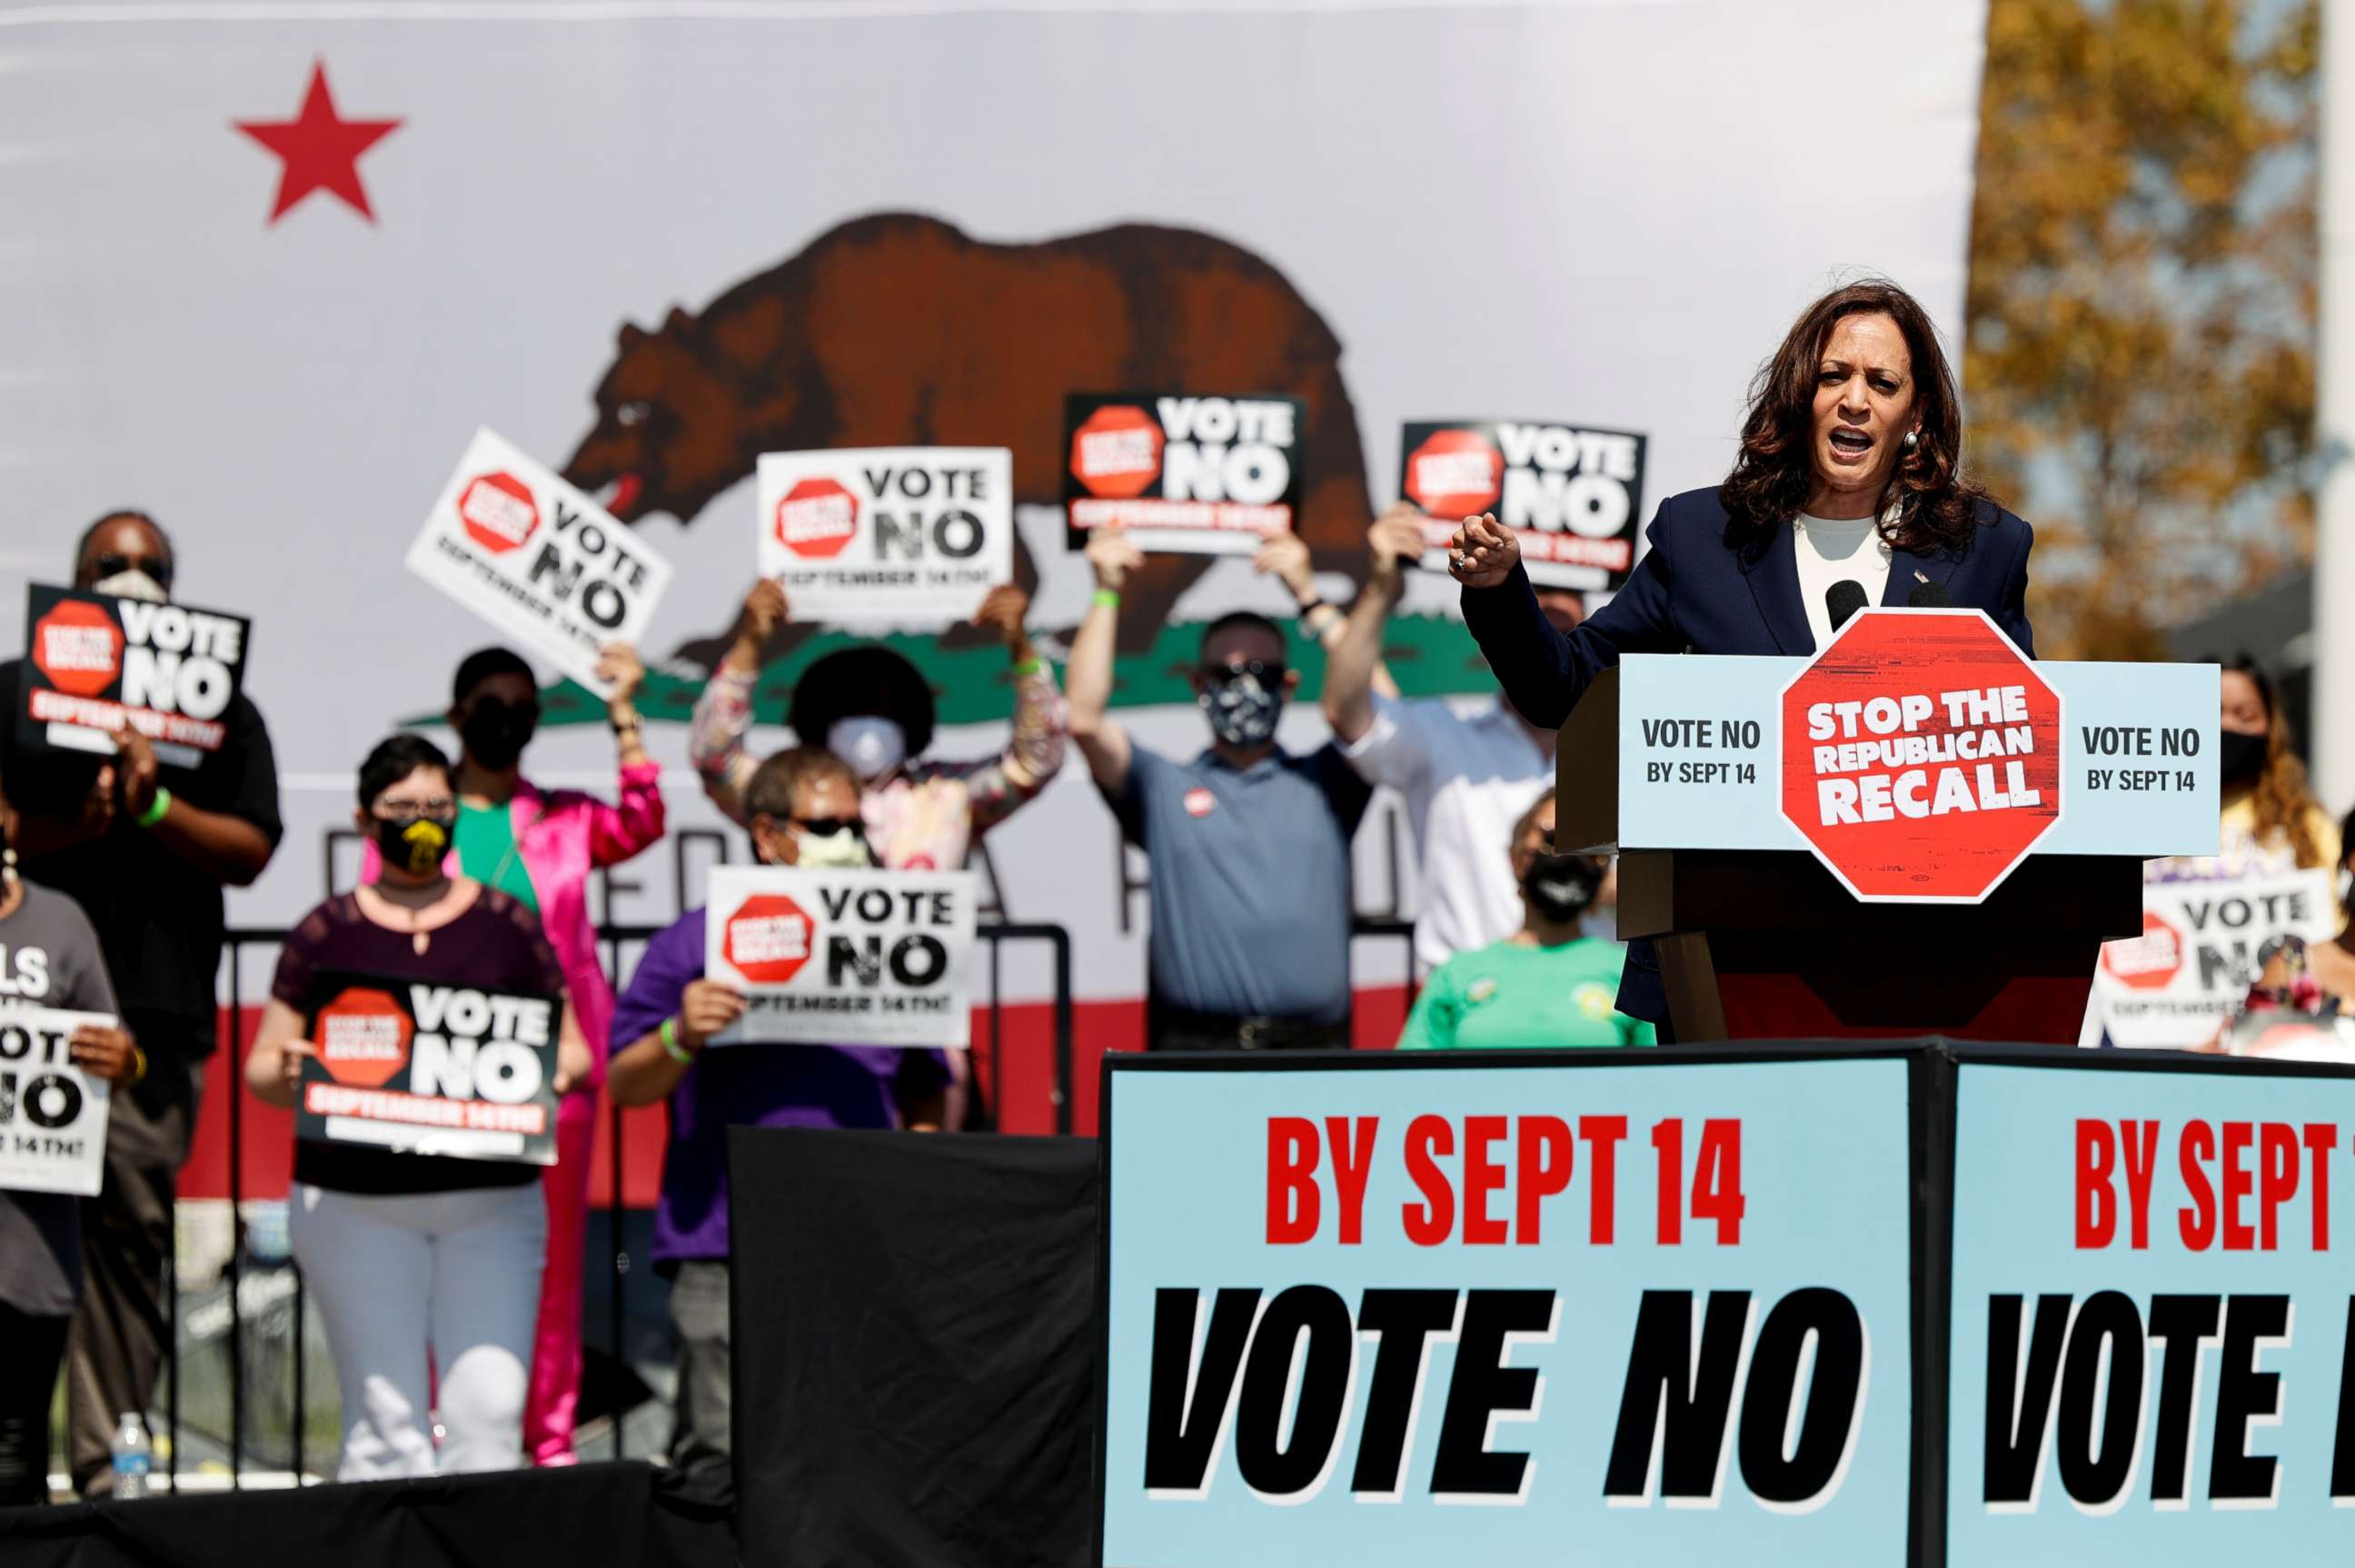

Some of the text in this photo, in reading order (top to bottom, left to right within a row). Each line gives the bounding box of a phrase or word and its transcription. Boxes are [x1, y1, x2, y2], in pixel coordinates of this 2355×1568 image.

[1157, 397, 1294, 448] VOTE
[1496, 422, 1636, 482] VOTE
[865, 467, 986, 499] VOTE
[1162, 441, 1290, 505] NO
[1500, 465, 1630, 539] NO
[554, 501, 648, 593] VOTE
[874, 510, 986, 560] NO
[529, 541, 627, 630] NO
[117, 599, 243, 665] VOTE
[120, 643, 233, 721] NO
[1642, 719, 1761, 749] VOTE NO
[1807, 685, 2029, 741] STOP THE
[2082, 726, 2200, 757] VOTE NO
[1647, 762, 1756, 785] BY SEPT 14
[1813, 725, 2035, 774] REPUBLICAN
[2088, 769, 2195, 791] BY SEPT 14
[1817, 760, 2042, 827] RECALL
[820, 888, 953, 925] VOTE
[2182, 891, 2312, 931] VOTE
[827, 934, 949, 988] NO
[410, 984, 552, 1047] VOTE
[410, 1031, 544, 1105] NO
[1266, 1114, 1745, 1246] BY SEPT 14
[2075, 1118, 2338, 1253] BY SEPT
[1144, 1285, 1867, 1510] VOTE NO
[1983, 1290, 2293, 1512] VOTE
